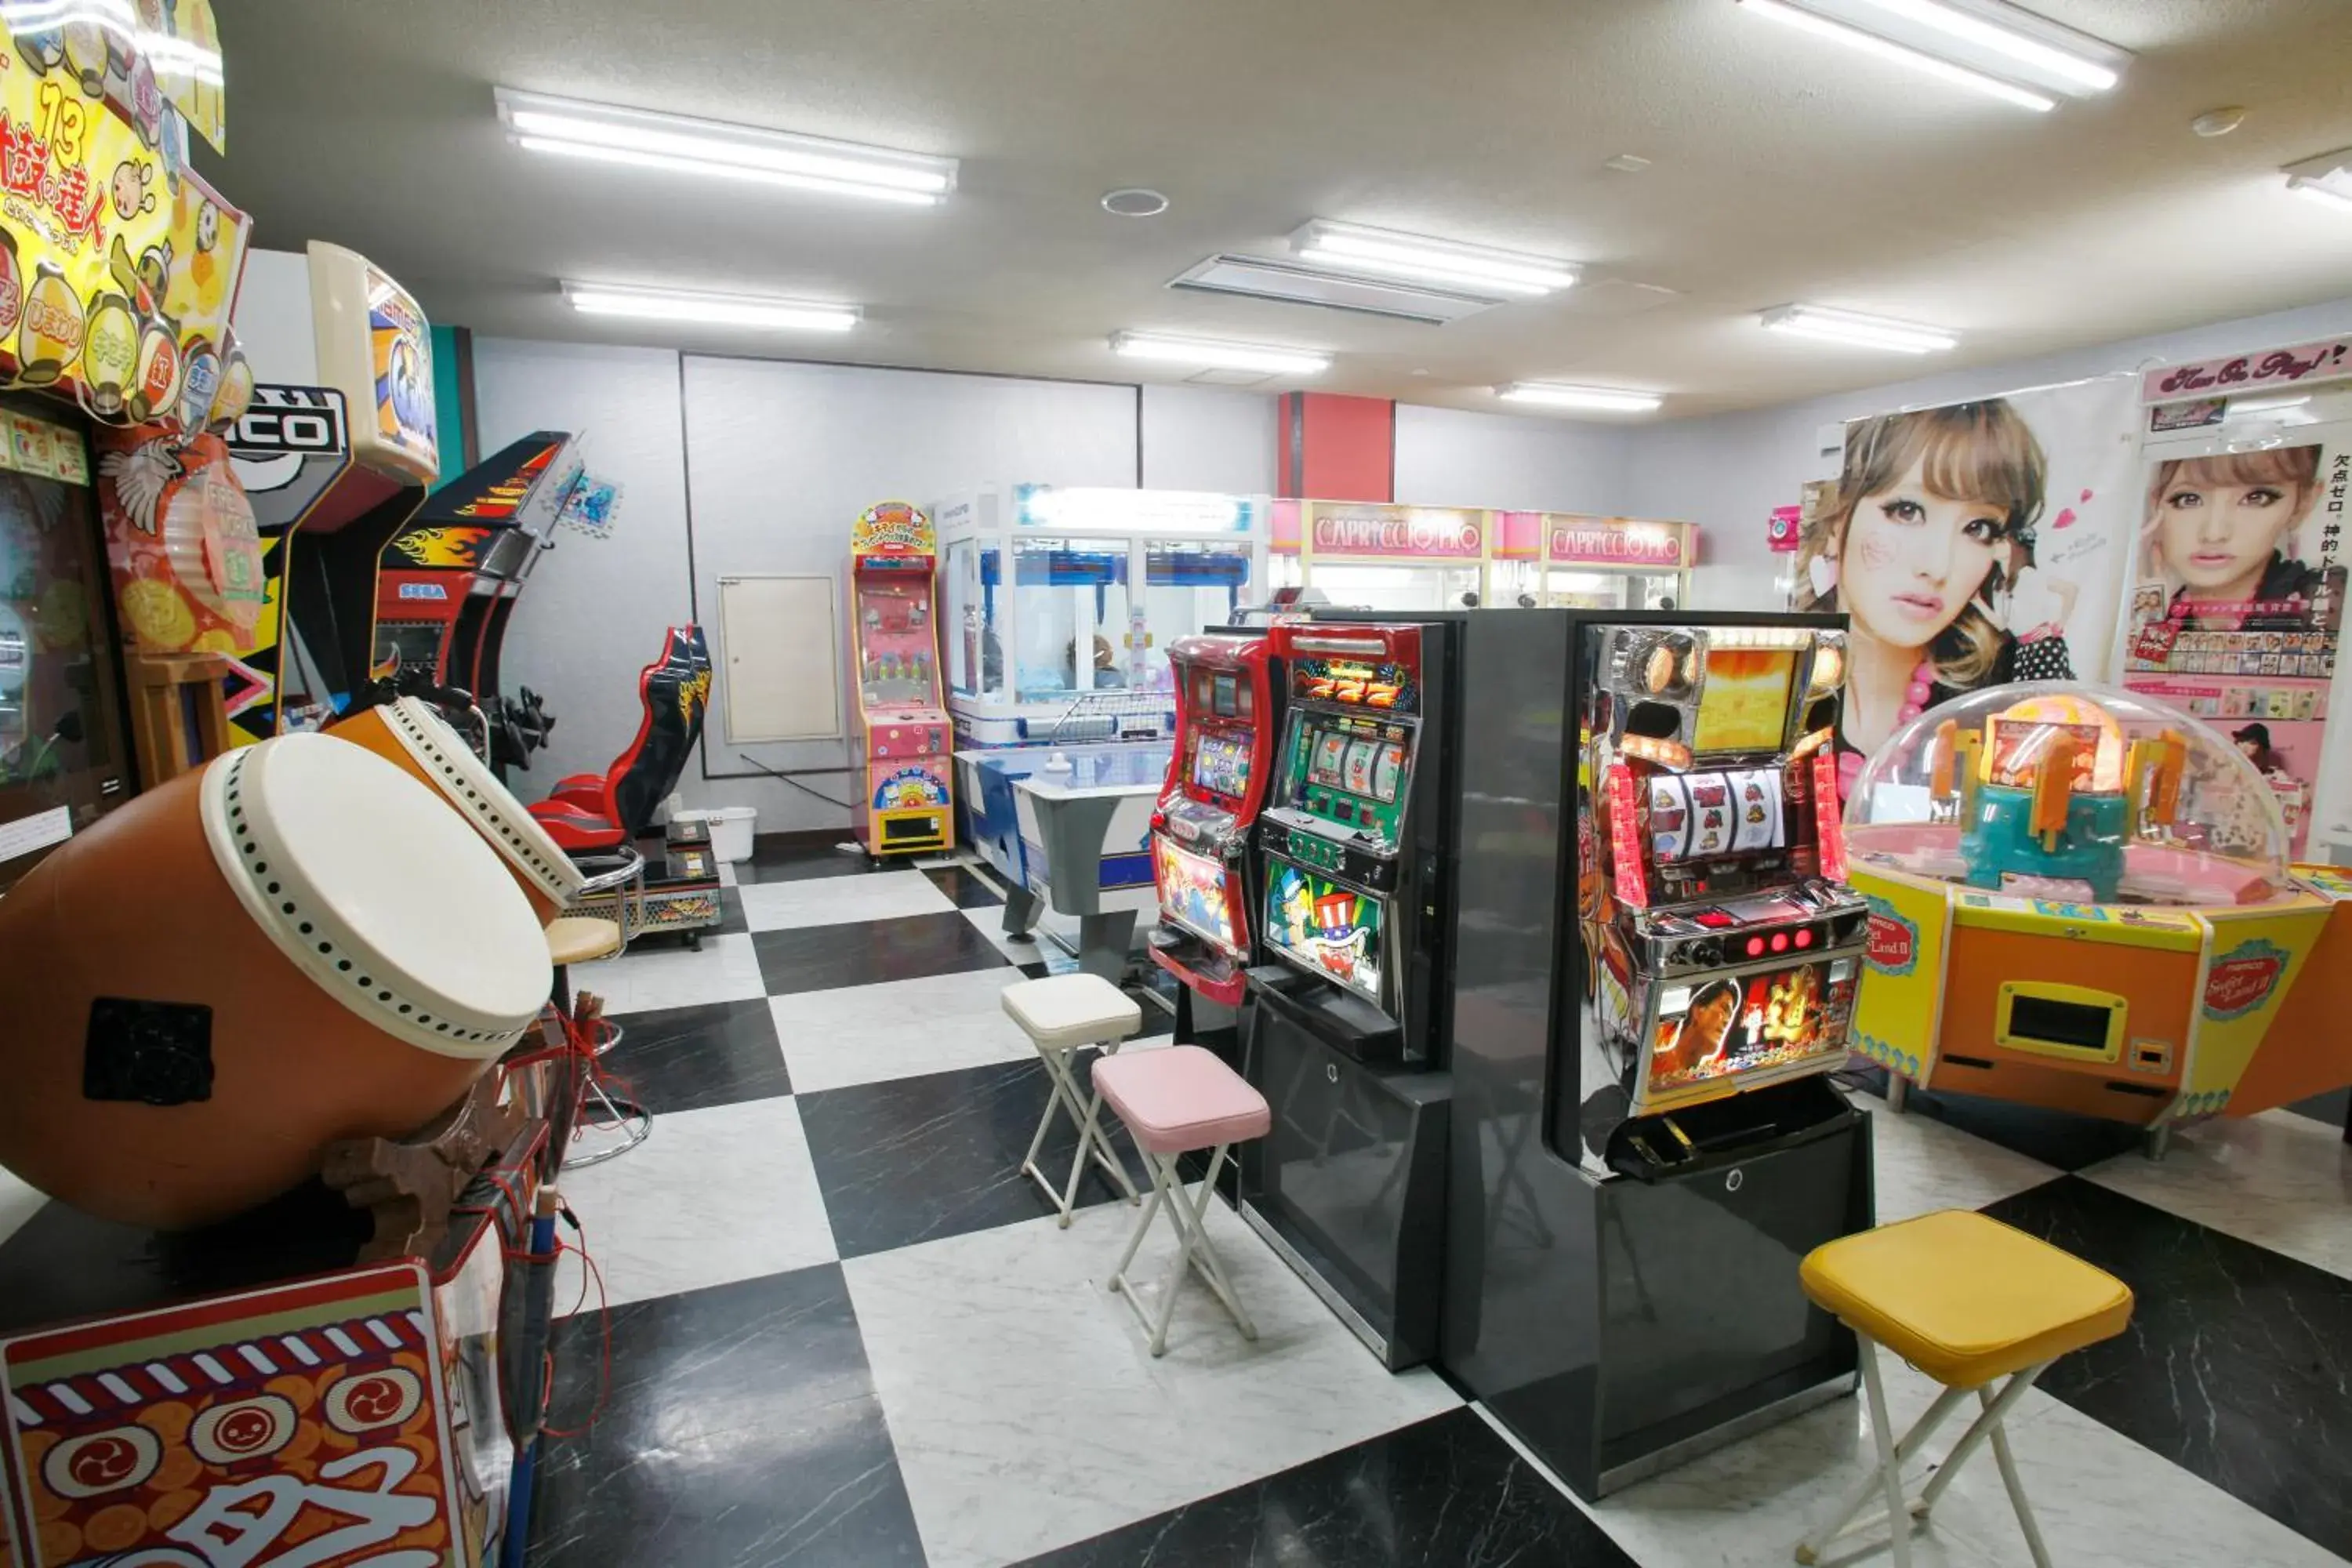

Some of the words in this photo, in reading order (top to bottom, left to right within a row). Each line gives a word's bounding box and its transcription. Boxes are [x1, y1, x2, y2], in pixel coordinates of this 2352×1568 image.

[40, 82, 85, 172] 13
[27, 298, 82, 348] ひまわり
[398, 583, 447, 600] SEGA
